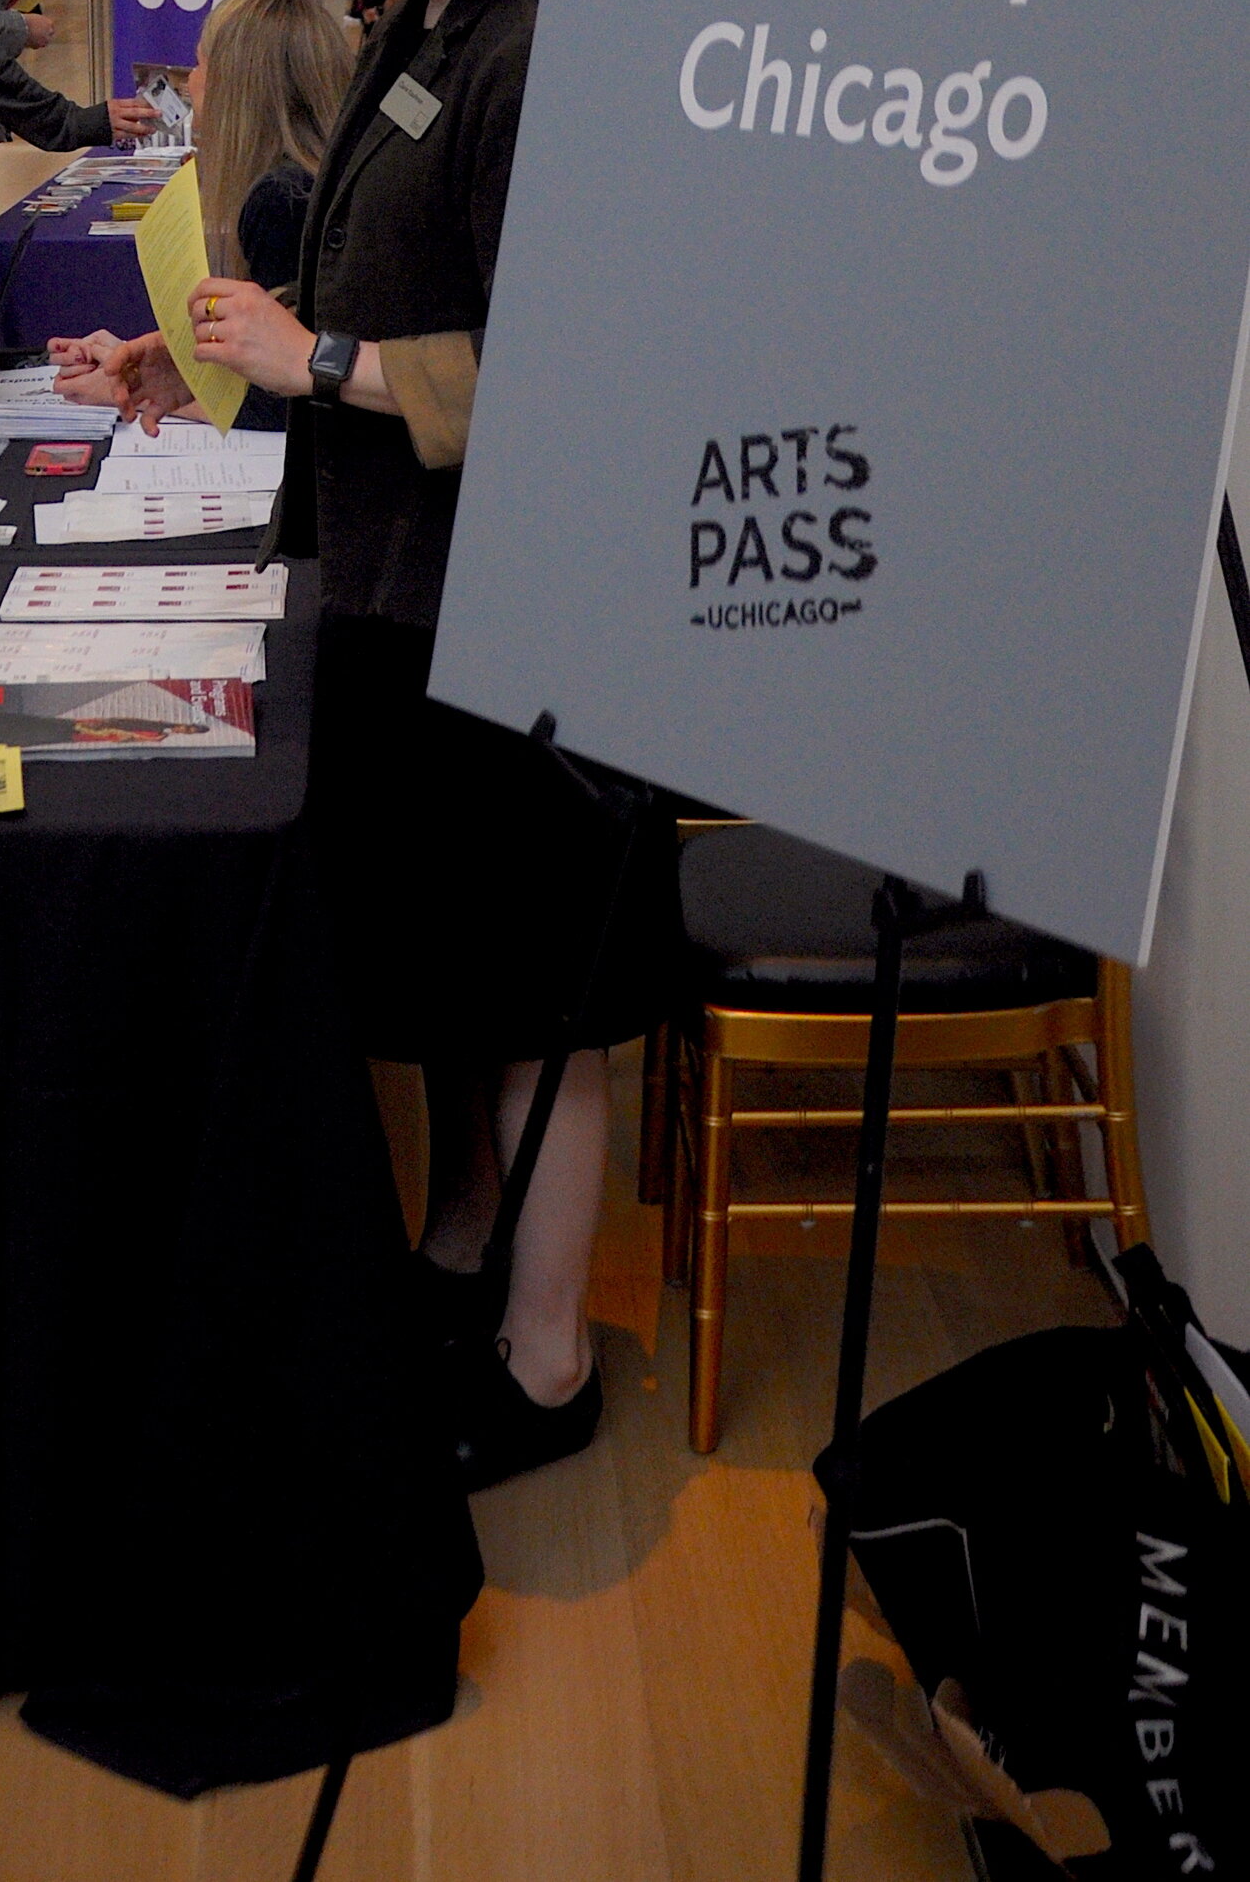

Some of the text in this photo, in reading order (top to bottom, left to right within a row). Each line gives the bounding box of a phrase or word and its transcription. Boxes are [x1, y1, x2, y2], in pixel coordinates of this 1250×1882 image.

[678, 21, 1048, 187] Chicago
[691, 423, 870, 506] ARTS
[689, 507, 878, 588] PASS
[1127, 1531, 1214, 1875] MEMBER
